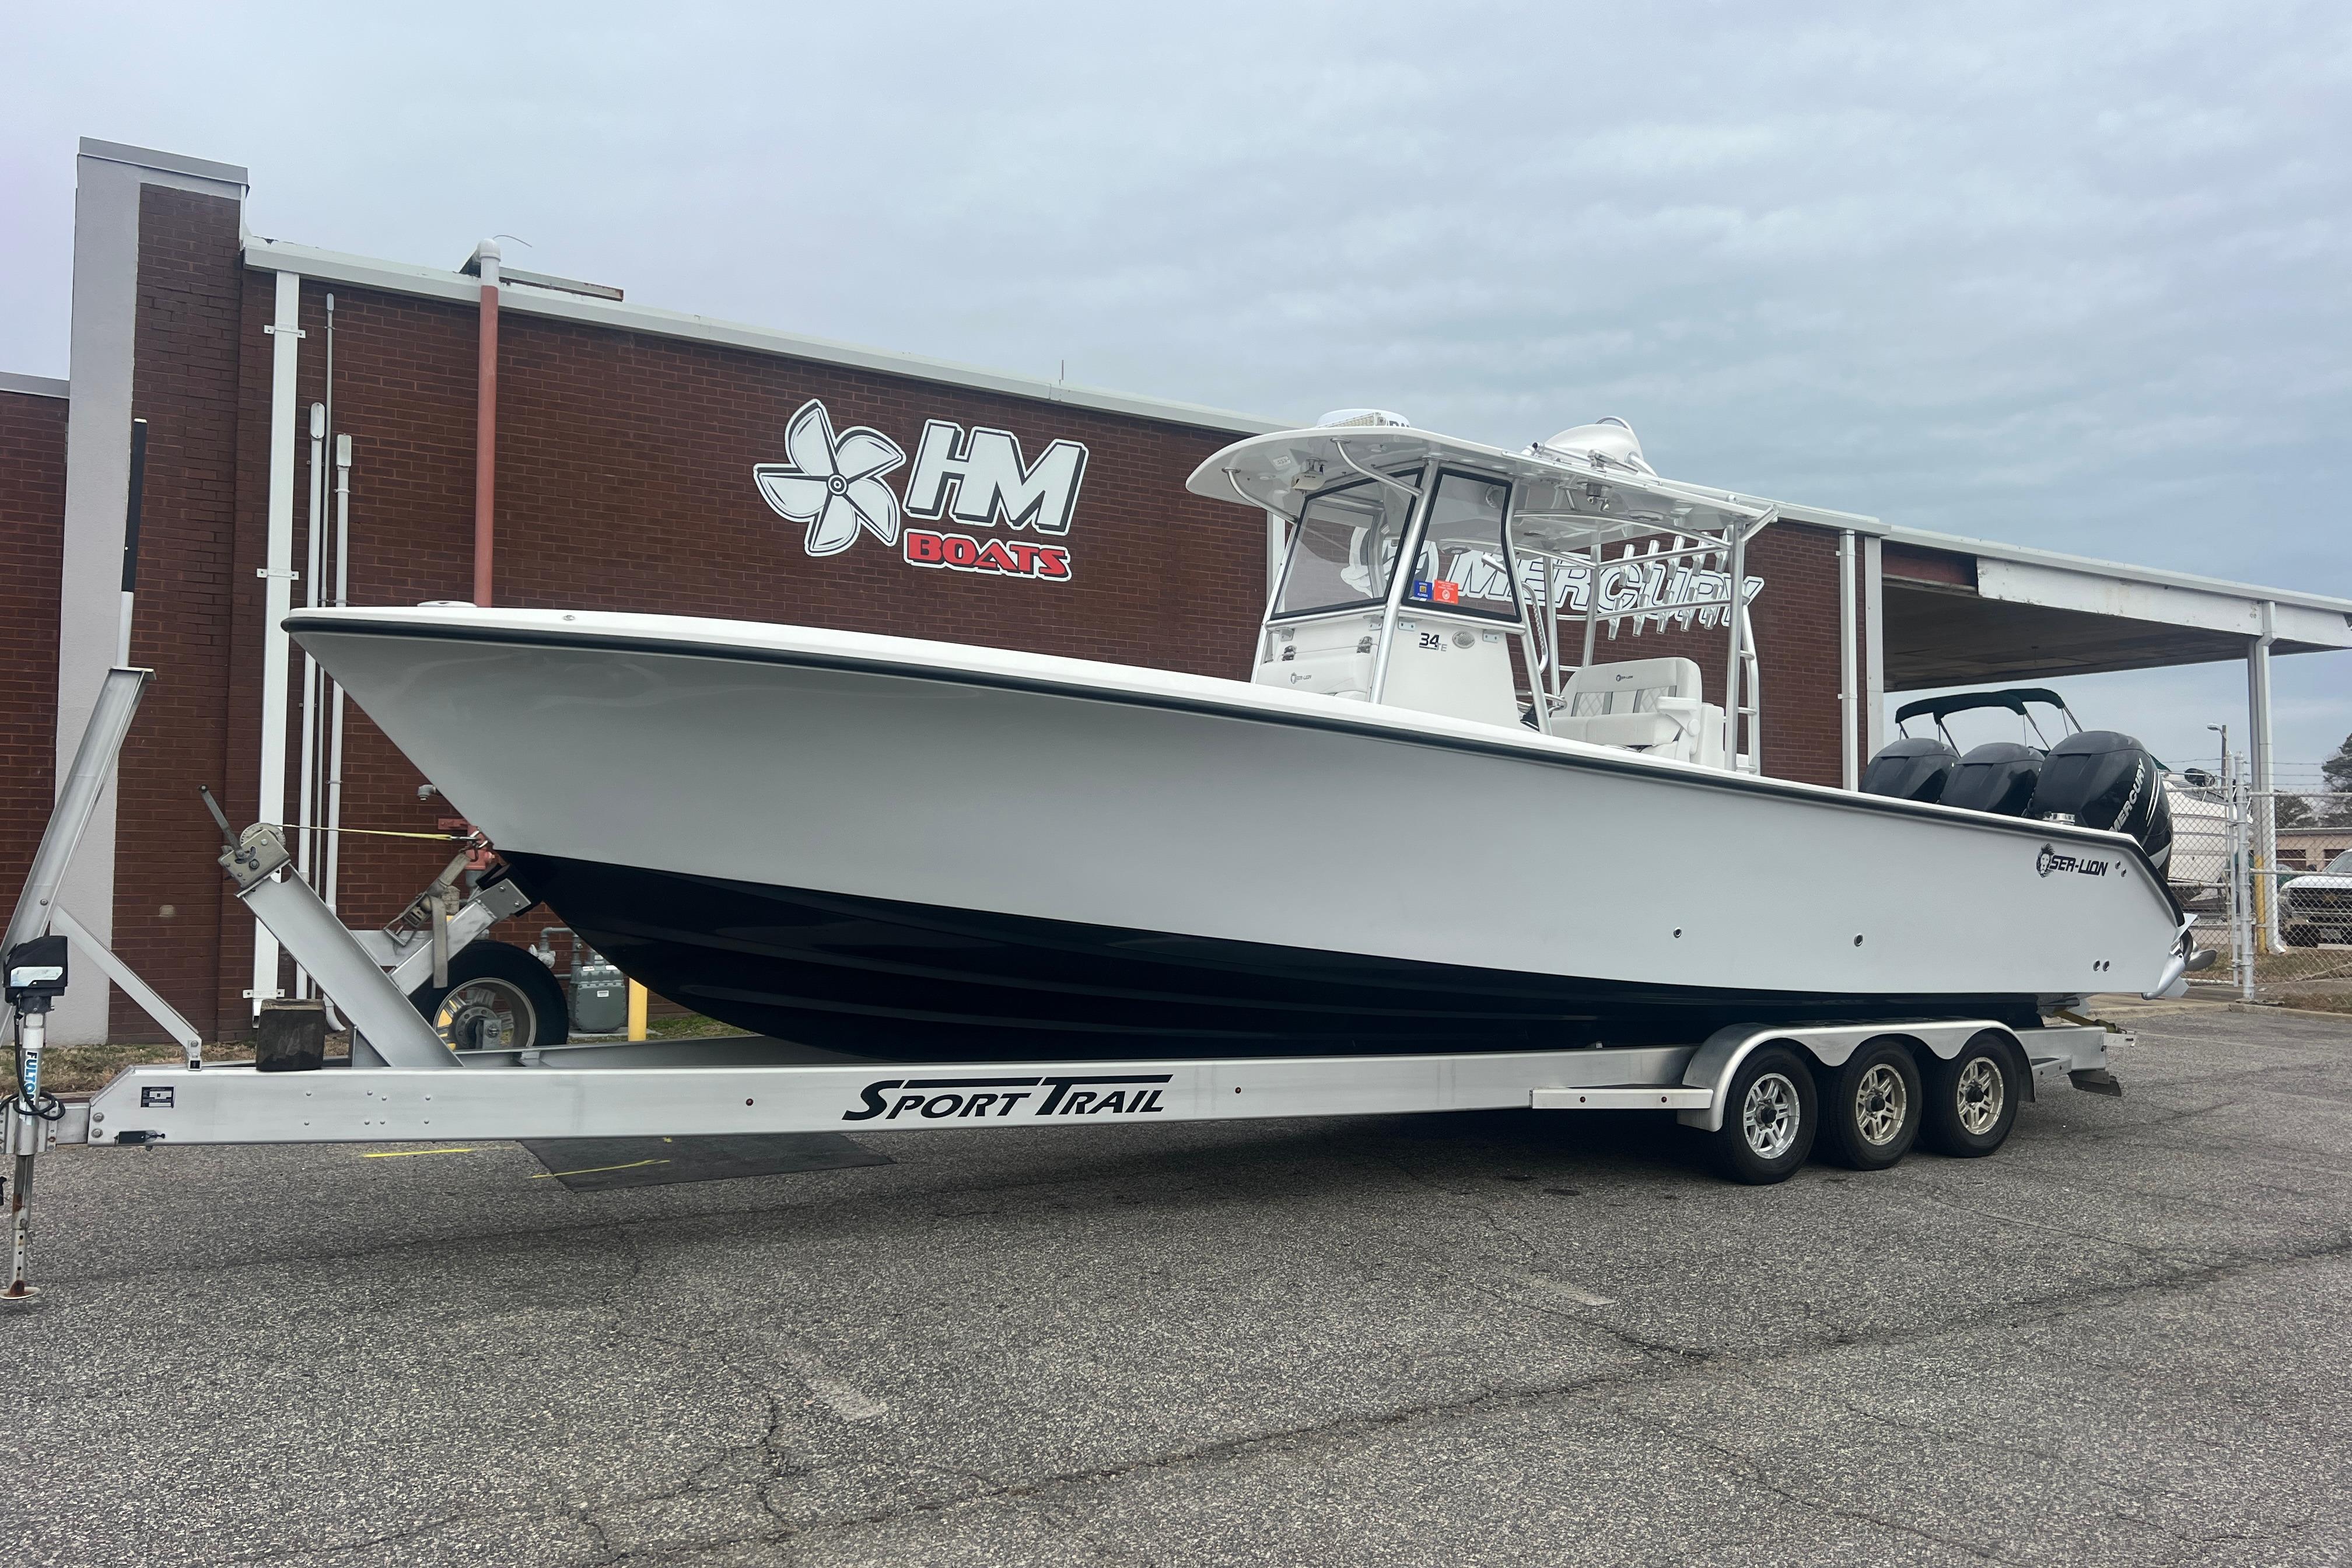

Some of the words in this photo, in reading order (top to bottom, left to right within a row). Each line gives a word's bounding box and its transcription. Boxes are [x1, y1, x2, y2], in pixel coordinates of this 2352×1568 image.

[904, 421, 1087, 534] HM
[907, 531, 1069, 579] BOATS
[2049, 855, 2109, 877] SEA-LION
[841, 1079, 1032, 1121] SPORT
[1035, 1074, 1174, 1116] TRAIL
